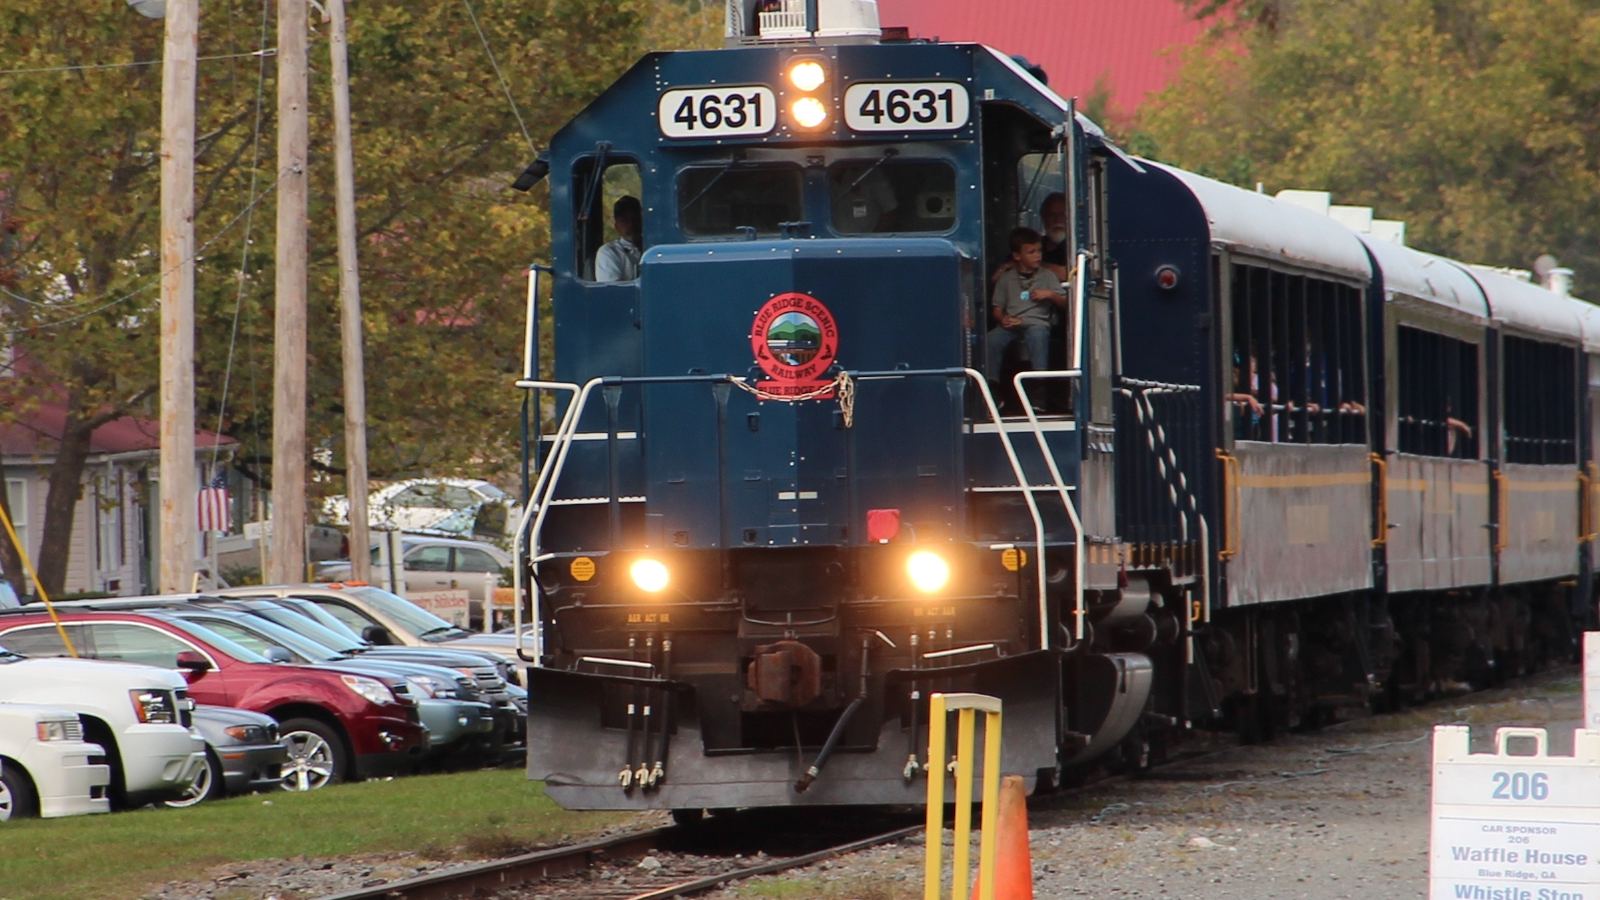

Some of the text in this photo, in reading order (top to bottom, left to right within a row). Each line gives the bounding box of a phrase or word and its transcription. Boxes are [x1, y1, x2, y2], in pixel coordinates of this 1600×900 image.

[674, 92, 762, 130] 4631
[859, 88, 954, 125] 4631
[755, 297, 835, 338] BLUE RIDGE SCENIC
[770, 363, 817, 380] RAILWAY
[1492, 771, 1549, 801] 206
[1481, 825, 1557, 835] CAR SPONSOR
[1508, 836, 1530, 845] 206
[1452, 846, 1588, 866] Waffle House
[1478, 868, 1557, 881] Blue Ridge, GA
[1454, 884, 1532, 900] Whistle
